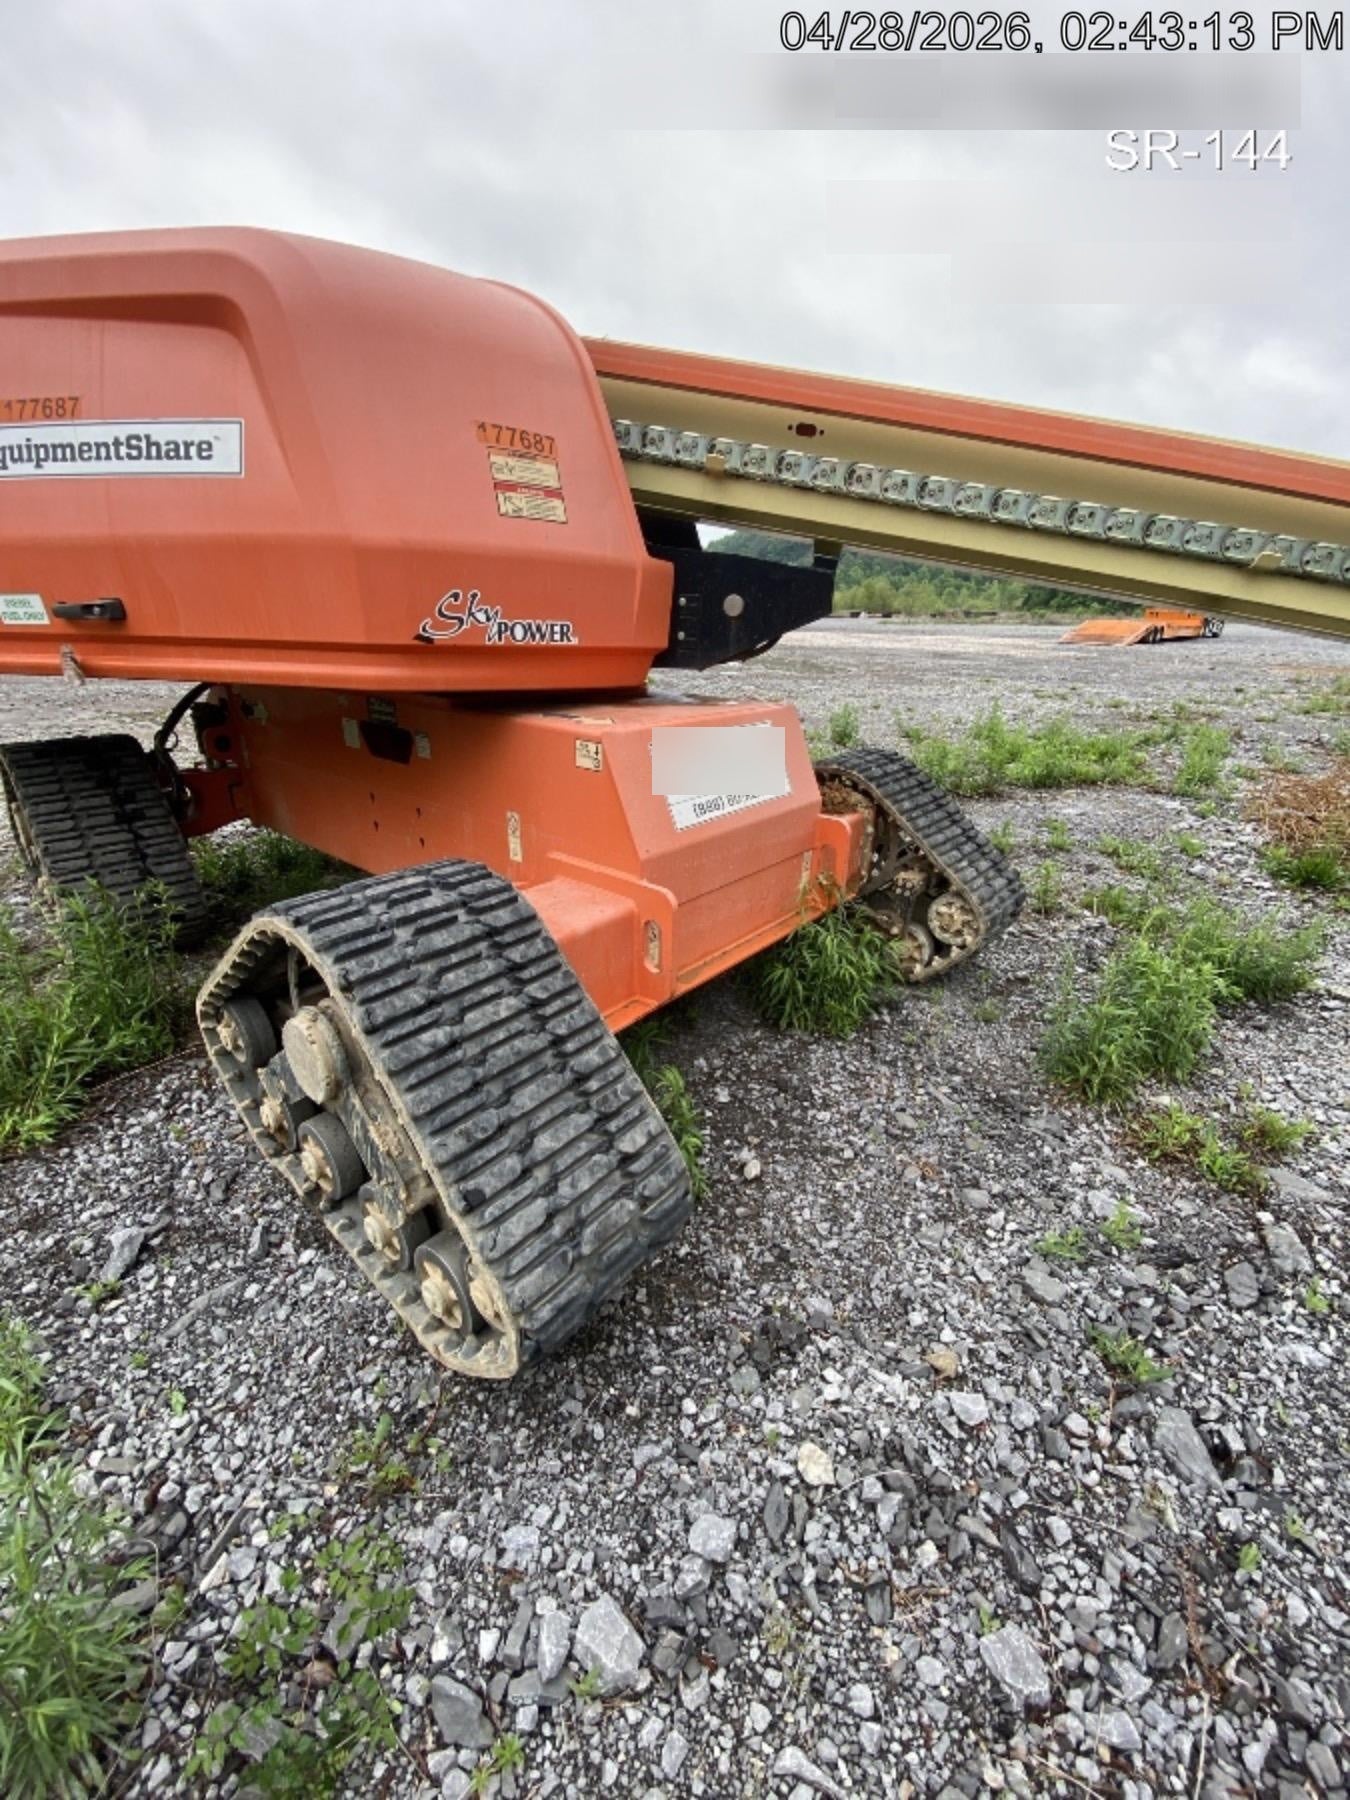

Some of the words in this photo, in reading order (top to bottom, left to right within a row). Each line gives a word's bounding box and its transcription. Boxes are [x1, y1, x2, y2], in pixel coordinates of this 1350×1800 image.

[3, 397, 80, 421] 177687
[477, 421, 556, 455] 177687
[496, 621, 574, 643] POWER
